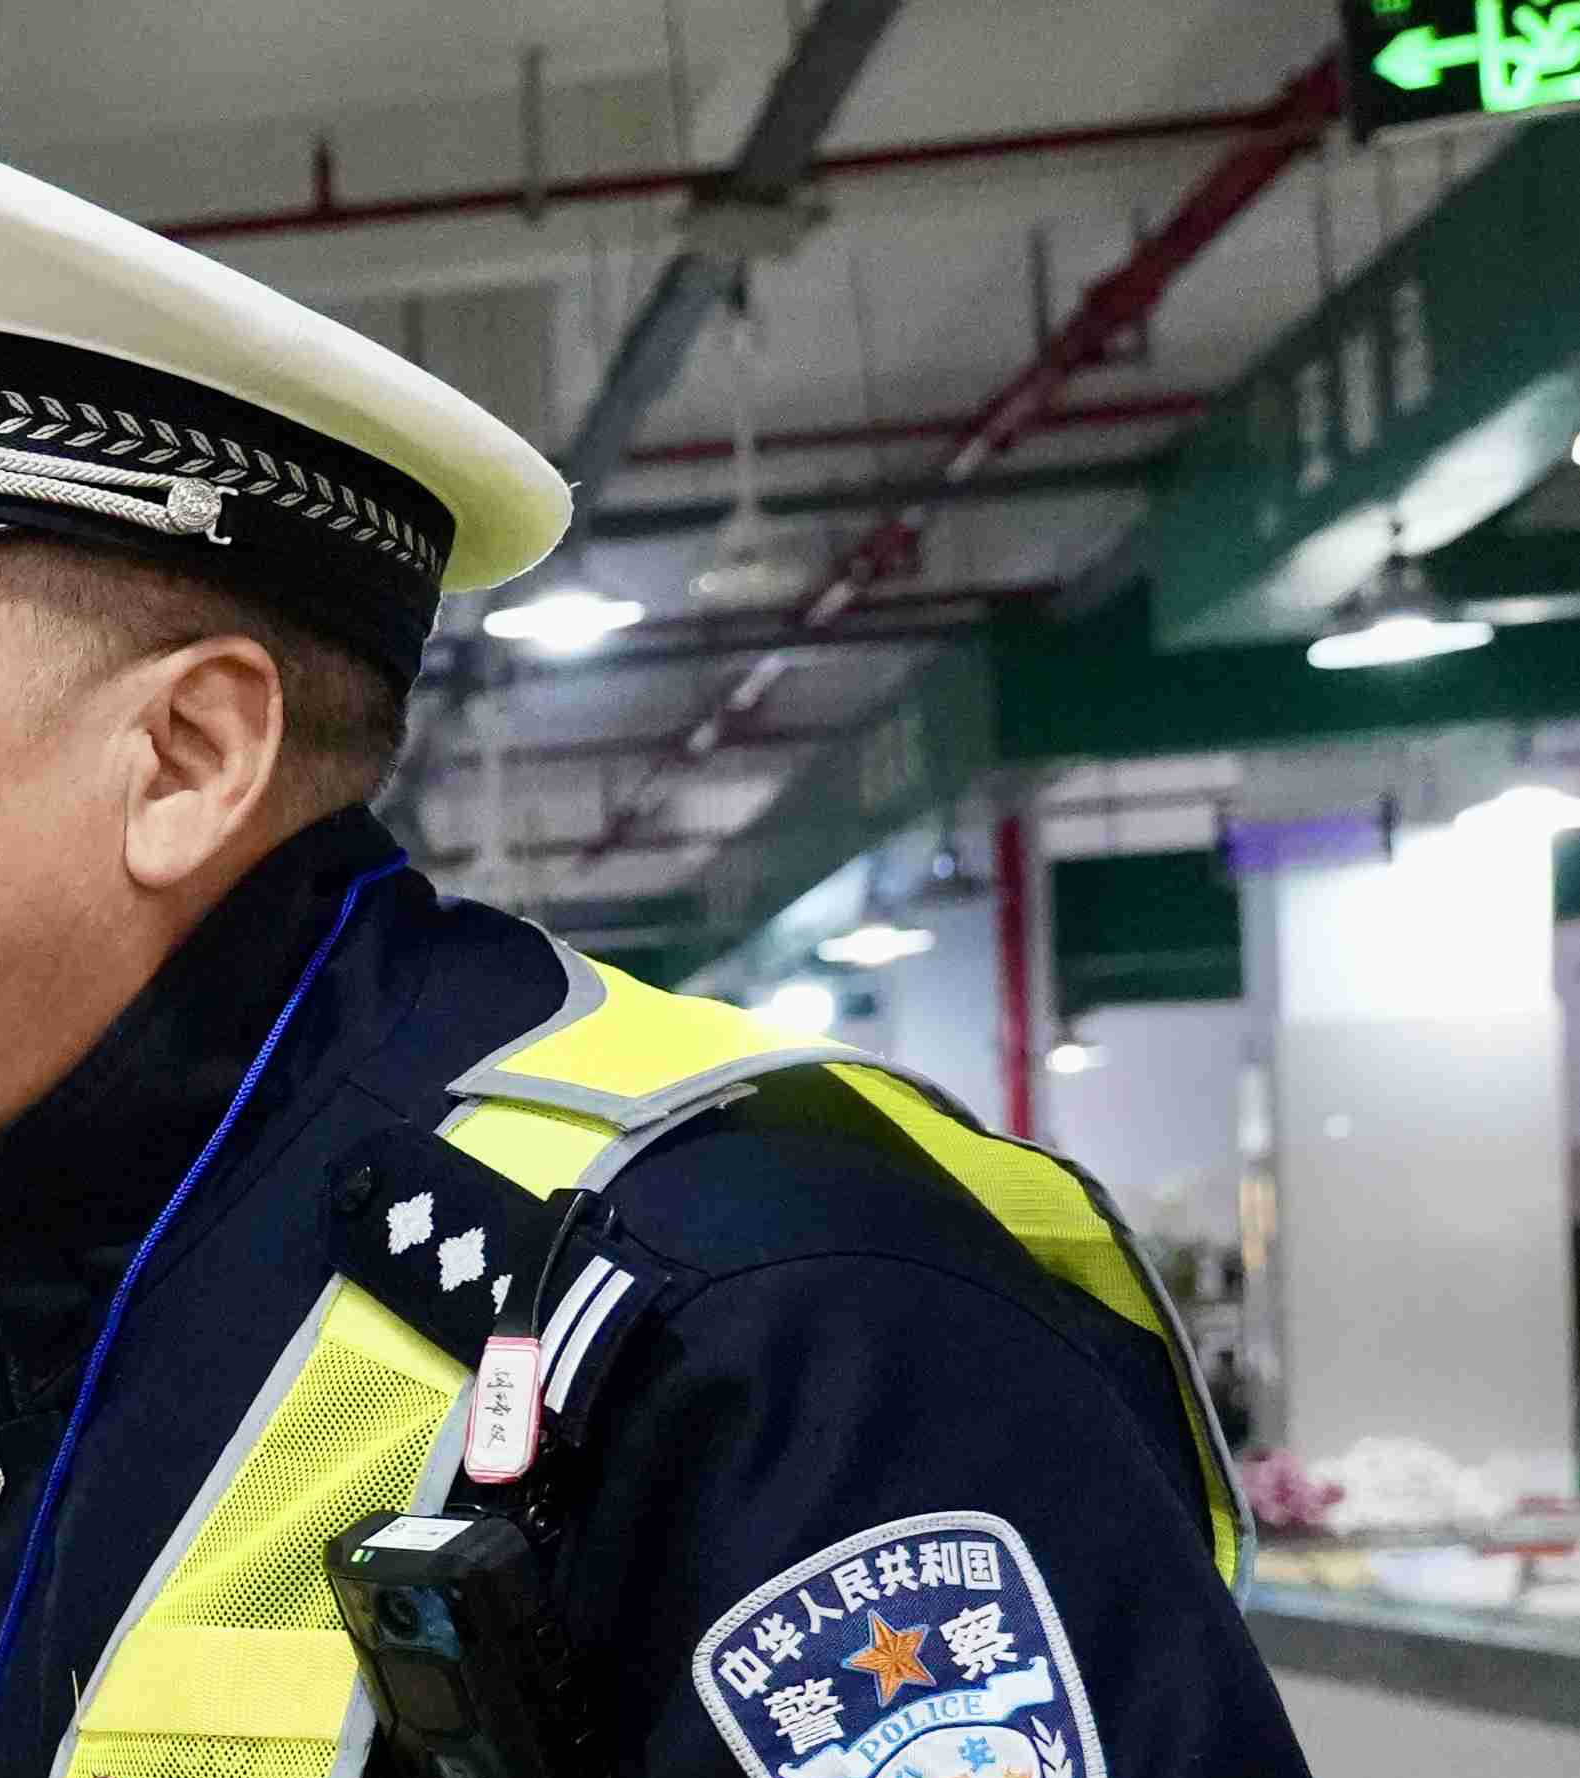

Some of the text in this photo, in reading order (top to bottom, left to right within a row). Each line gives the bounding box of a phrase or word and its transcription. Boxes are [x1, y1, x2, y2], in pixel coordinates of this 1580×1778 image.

[717, 1540, 1003, 1699] 中华人民共和国
[763, 1601, 1019, 1755] 警察
[857, 1692, 988, 1768] POLICE
